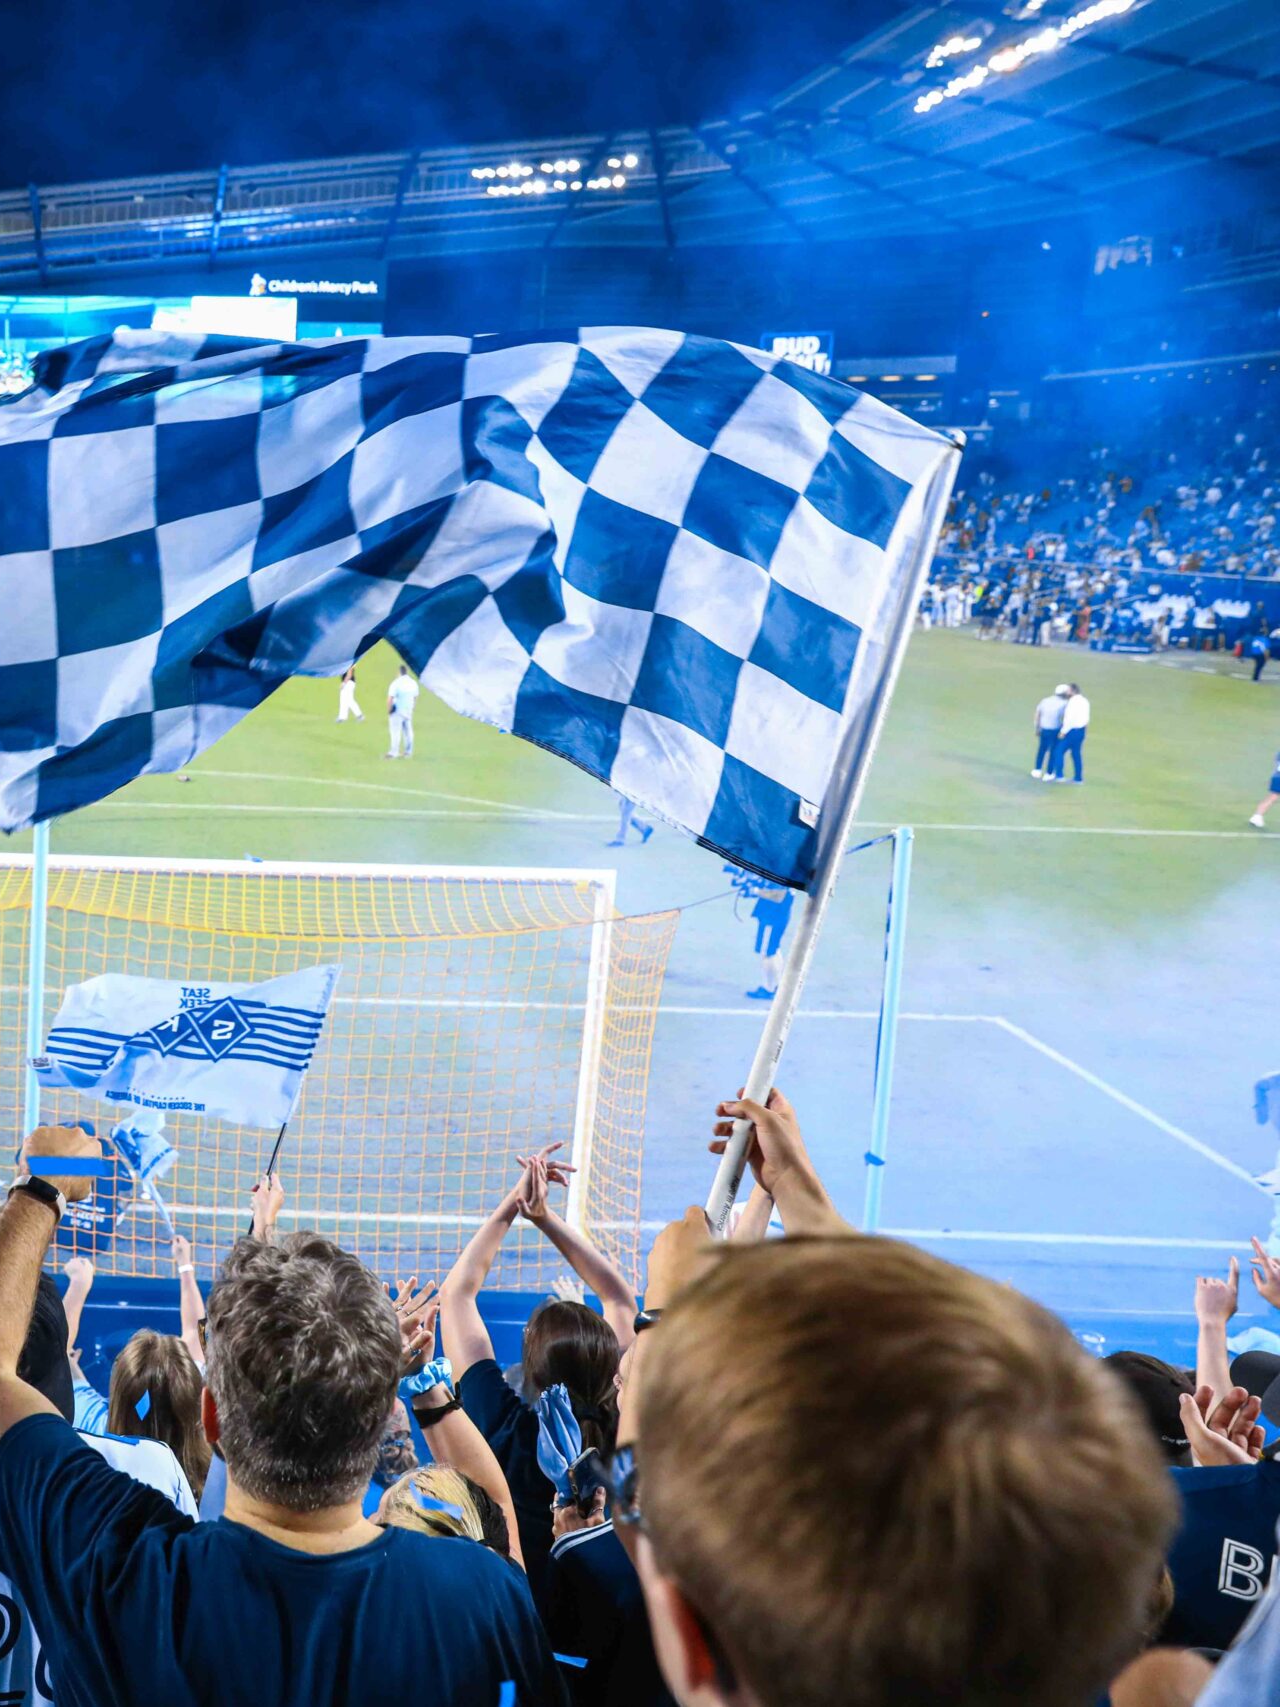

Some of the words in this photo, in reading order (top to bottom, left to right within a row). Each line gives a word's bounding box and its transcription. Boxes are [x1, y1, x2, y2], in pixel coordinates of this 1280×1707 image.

[319, 280, 351, 296] Mercy
[351, 281, 378, 294] Park
[772, 335, 820, 355] BUD
[1218, 1537, 1280, 1601] B
